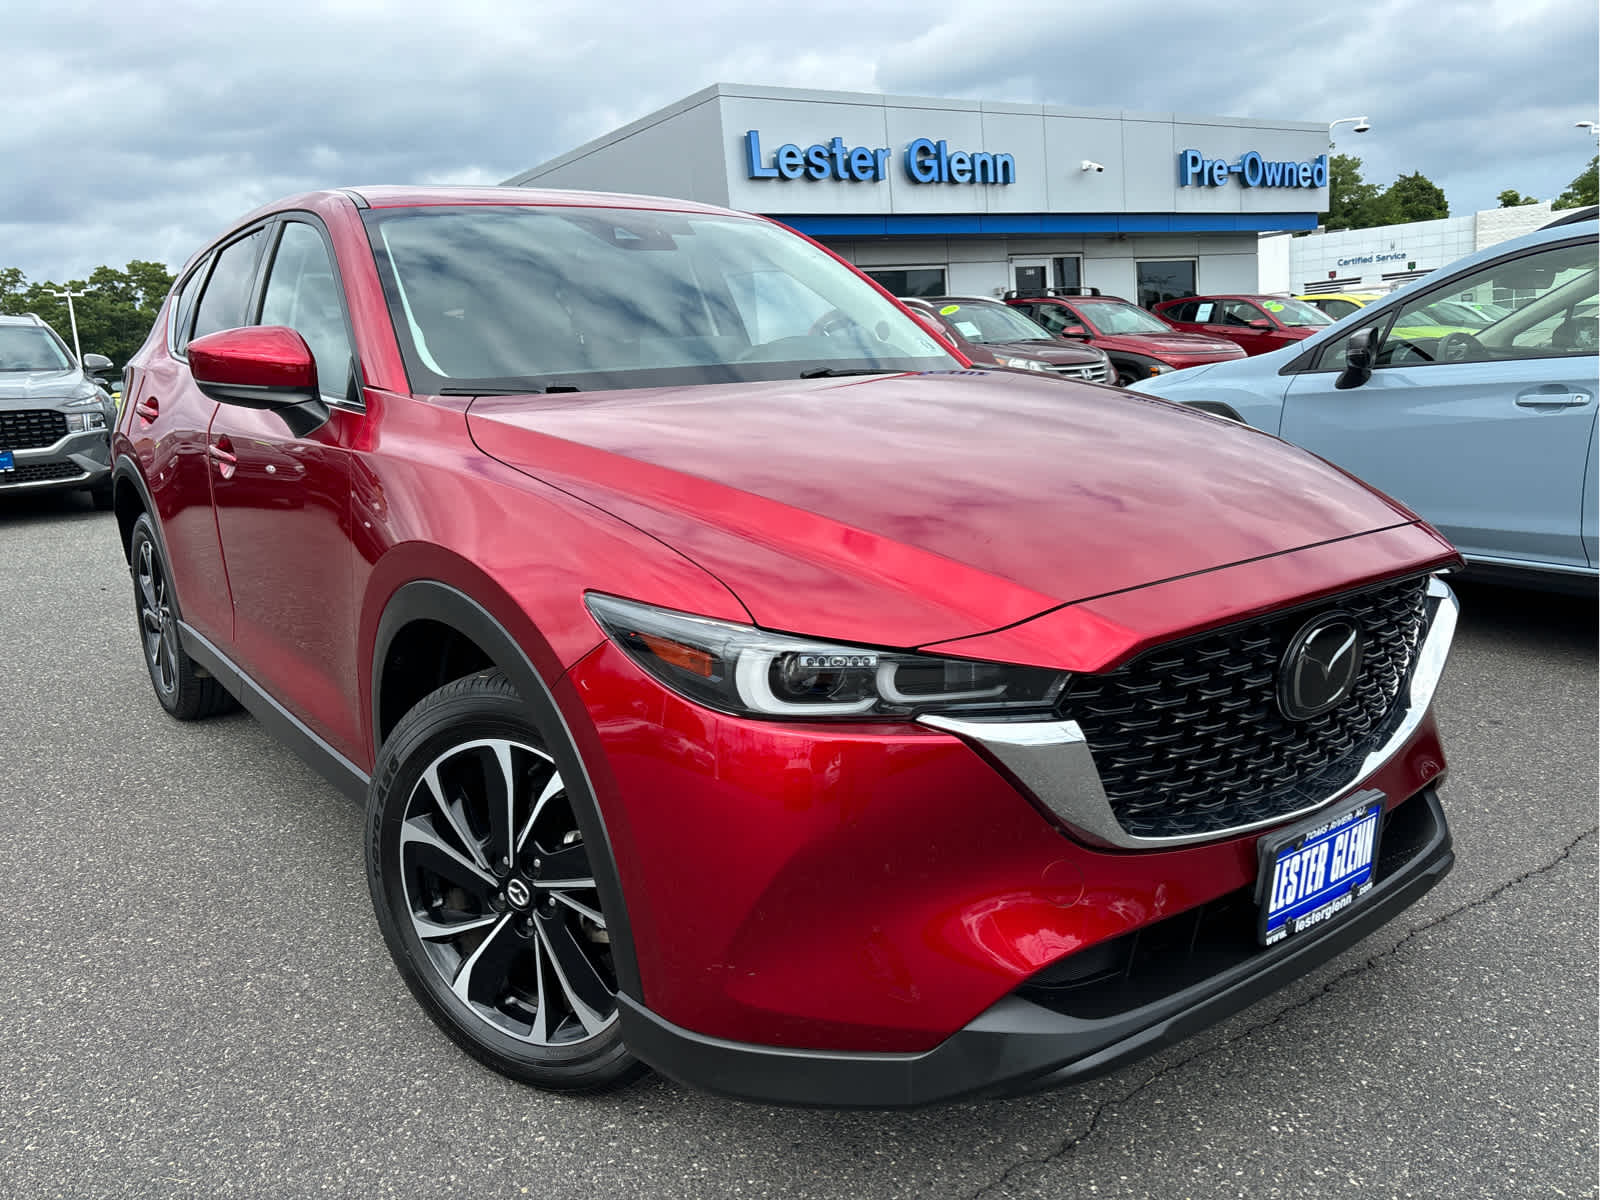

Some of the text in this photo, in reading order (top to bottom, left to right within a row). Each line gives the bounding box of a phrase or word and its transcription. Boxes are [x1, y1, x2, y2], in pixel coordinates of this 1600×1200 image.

[745, 130, 1016, 184] Lester Glenn
[1180, 149, 1327, 188] Pre-Owned
[1337, 252, 1407, 267] Certified Service
[1305, 824, 1328, 842] TOMS
[1329, 813, 1353, 831] RIVER
[1268, 816, 1377, 914] LESTER GLENN
[1295, 894, 1353, 933] lesterglenn
